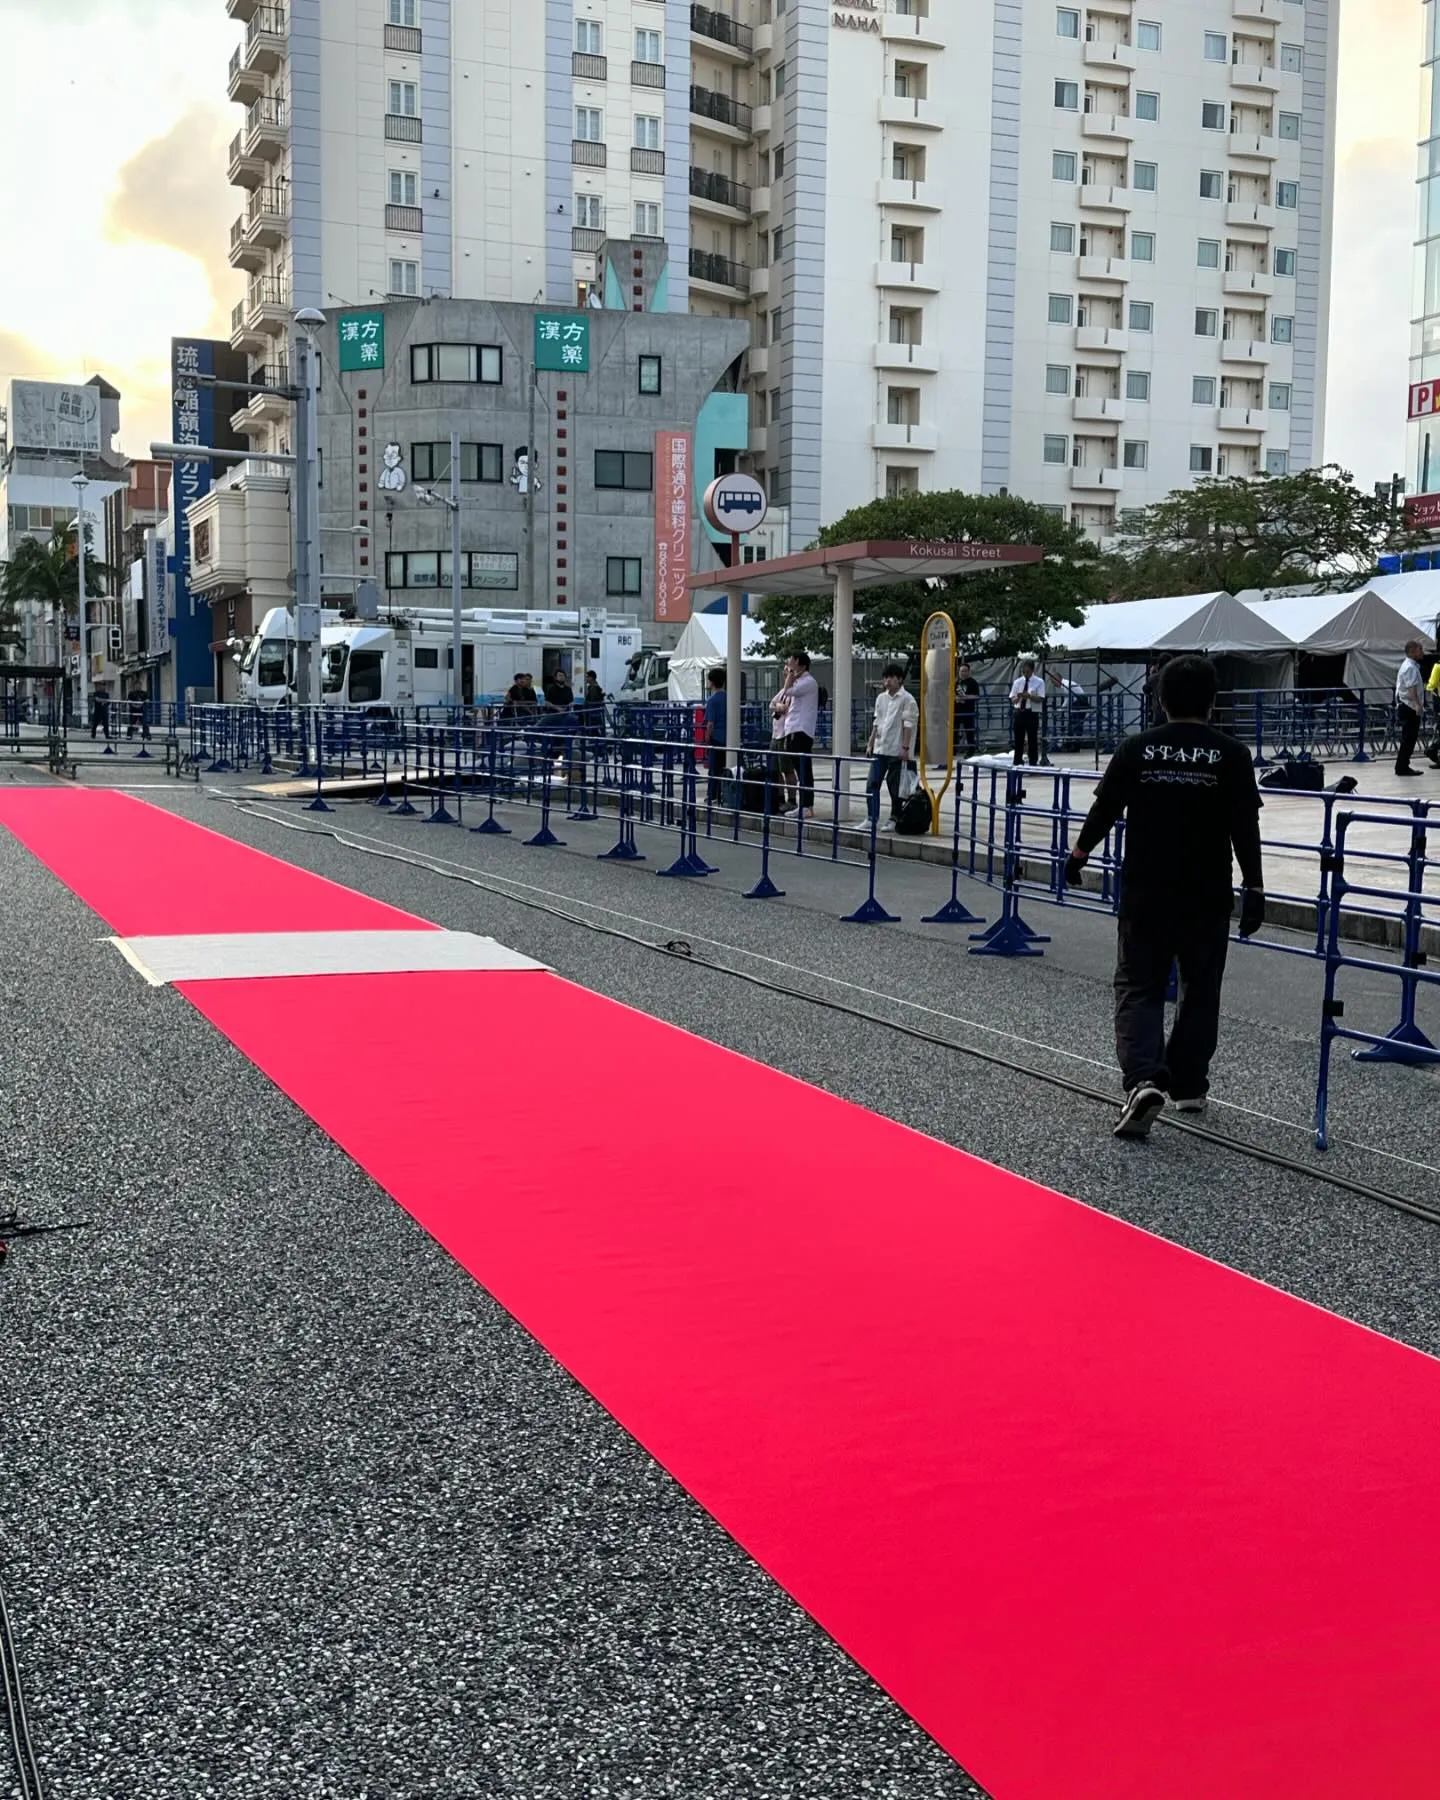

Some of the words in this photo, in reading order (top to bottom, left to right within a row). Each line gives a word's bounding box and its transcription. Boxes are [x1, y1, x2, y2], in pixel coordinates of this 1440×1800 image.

[832, 12, 880, 31] NAHA
[341, 320, 379, 340] 漢方
[540, 320, 585, 341] 漢方
[361, 342, 378, 361] 薬
[562, 344, 583, 364] 薬
[1418, 386, 1429, 412] P
[671, 438, 686, 600] 国際通り歯科クリニック
[910, 544, 957, 557] Kokusai
[962, 546, 1001, 558] Street
[1142, 745, 1222, 764] STAFF
